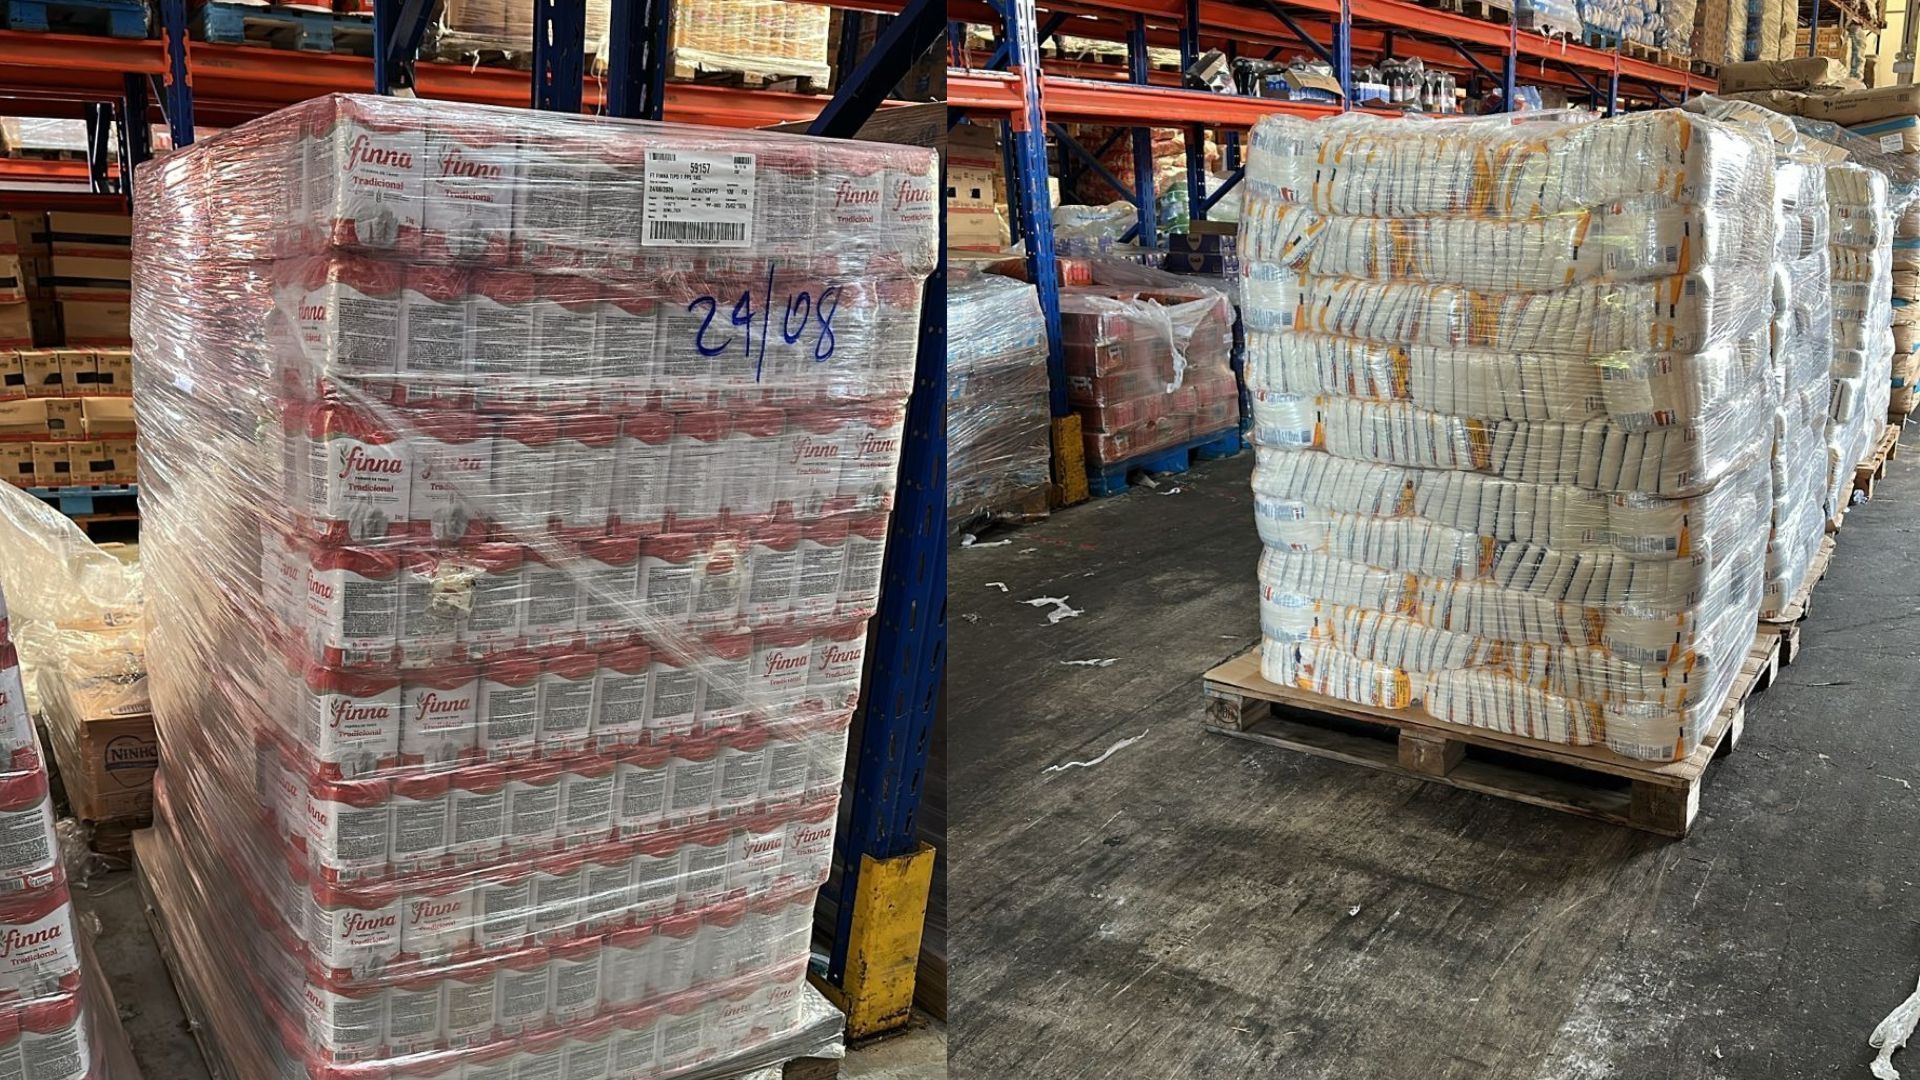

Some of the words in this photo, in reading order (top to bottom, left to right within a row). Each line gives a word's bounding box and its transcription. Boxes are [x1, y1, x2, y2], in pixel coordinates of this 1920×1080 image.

[343, 134, 413, 171] finna
[690, 162, 711, 174] 59157
[352, 175, 404, 191] Tradicional
[444, 189, 494, 203] Tradicional
[687, 263, 842, 383] 24/08
[339, 446, 403, 479] finna
[789, 436, 839, 464] finna
[349, 483, 394, 493] Tradicional
[763, 651, 808, 677] finna
[819, 645, 862, 670] finna
[330, 700, 390, 728] finna
[415, 693, 471, 720] finna
[342, 912, 396, 938] finna
[410, 900, 461, 924] finna
[0, 925, 62, 958] finna
[10, 948, 58, 966] Tradicional
